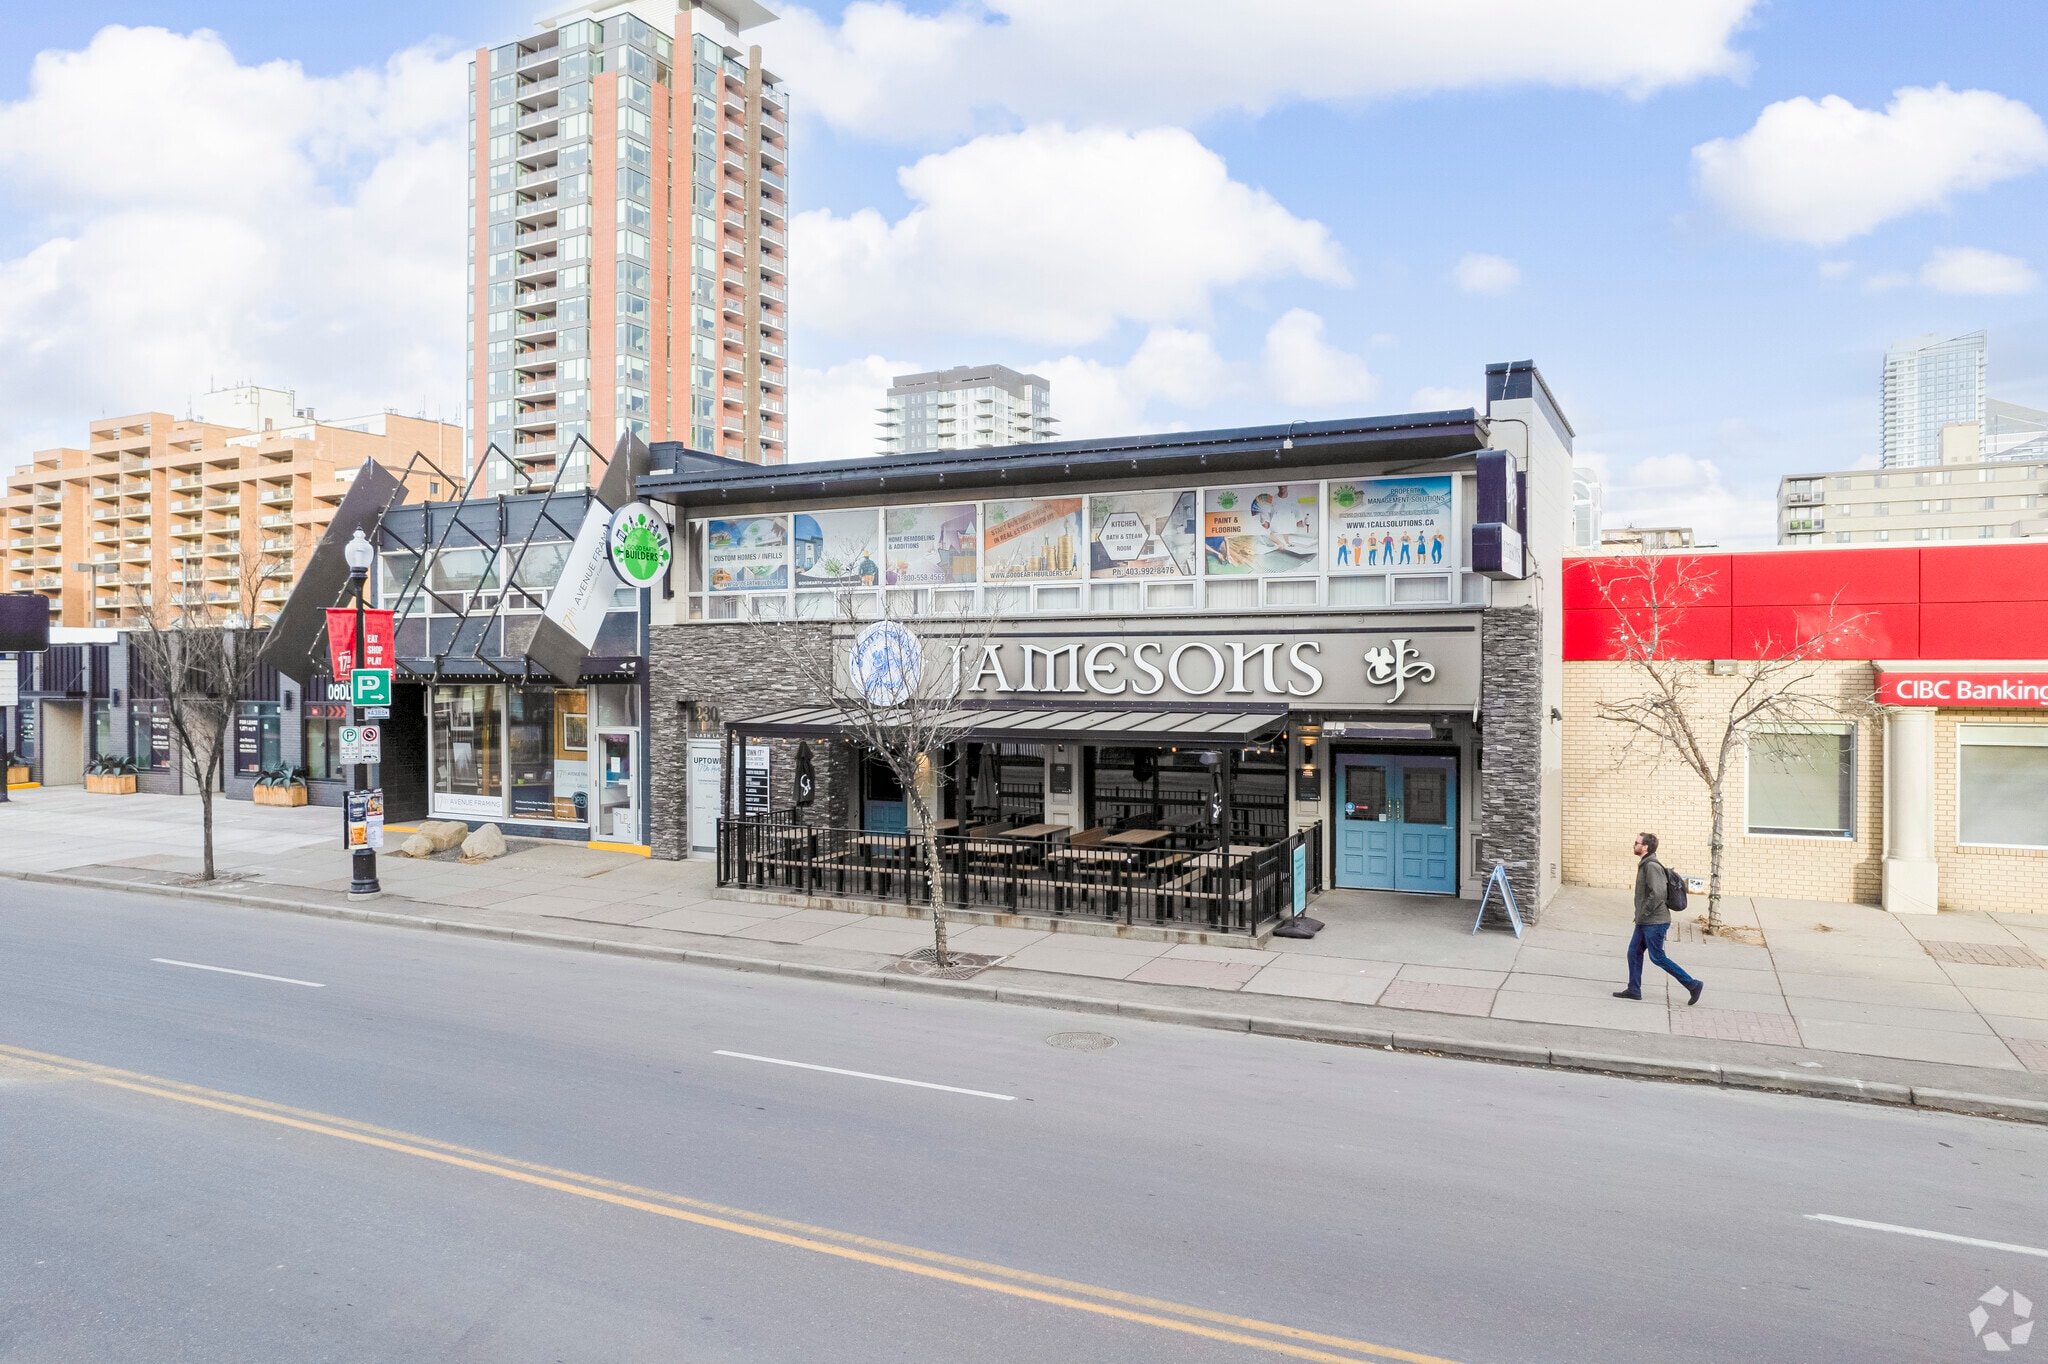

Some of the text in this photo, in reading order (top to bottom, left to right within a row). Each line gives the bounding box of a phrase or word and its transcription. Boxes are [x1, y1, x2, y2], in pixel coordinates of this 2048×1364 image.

[1390, 487, 1421, 495] PROPERTY
[1367, 495, 1444, 504] MANAGEMENT SOLUTIONS
[1111, 520, 1137, 528] KITCHEN
[1213, 517, 1231, 525] PAINT
[1346, 519, 1434, 529] WWW.1CALLSOLUTIONS.CA
[1211, 525, 1241, 534] FLOORING
[903, 534, 935, 542] REMODELING
[1000, 532, 1013, 541] REAL
[893, 542, 919, 550] ADDITIONS
[625, 549, 658, 562] BUILDERS
[713, 554, 736, 562] CUSTOM
[737, 553, 757, 561] HOMES
[762, 551, 783, 560] INFILLS
[990, 570, 1072, 579] WWW.GOODEARTHBUILDERS.CA
[1125, 566, 1174, 575] 403-992-8476
[574, 562, 598, 606] AVENUE
[367, 635, 378, 643] EAT
[367, 646, 383, 654] SHOP
[367, 657, 382, 665] PLAY
[946, 641, 1323, 700] JAMESONS
[328, 684, 352, 700] OODL
[358, 676, 380, 699] P
[1896, 680, 2048, 705] CIBC Banking
[346, 731, 354, 739] P
[450, 798, 473, 806] AVENUE
[474, 800, 501, 808] FRAMING
